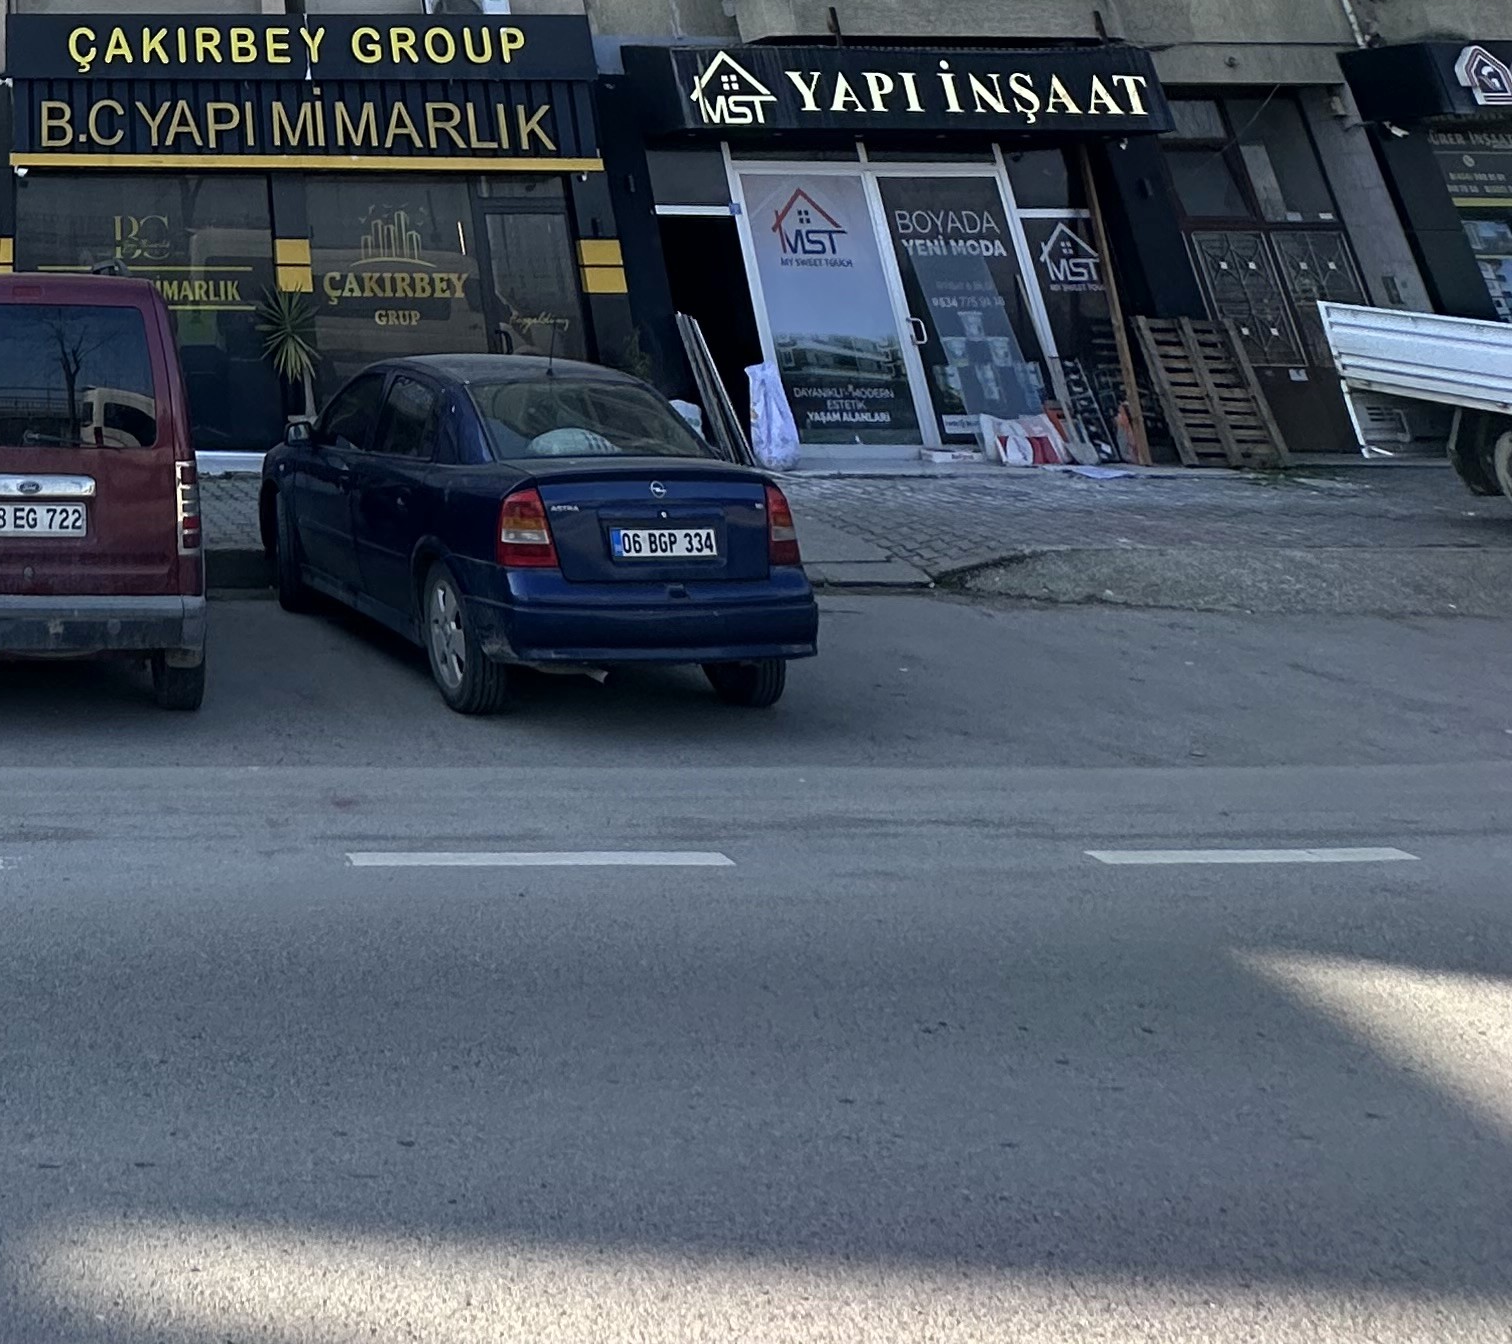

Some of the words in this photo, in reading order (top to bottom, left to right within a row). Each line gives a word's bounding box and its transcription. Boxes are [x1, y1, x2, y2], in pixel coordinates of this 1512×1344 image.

[68, 27, 325, 72] ÇAKIRBEY
[351, 27, 527, 64] GROUP
[701, 96, 777, 124] MST
[785, 70, 923, 113] YAPI
[937, 59, 1149, 124] İNŞAAT
[135, 99, 255, 150] YAPI
[271, 86, 558, 151] MİMARLIK
[895, 210, 1001, 234] BOYADA
[778, 228, 848, 255] MST
[901, 234, 949, 257] YENİ
[949, 239, 1007, 257] MODA
[1044, 257, 1100, 281] MST
[323, 272, 470, 305] ÇAKIRBEY
[374, 310, 422, 326] GRUP
[13, 507, 38, 529] EG
[46, 508, 83, 530] 722
[622, 532, 642, 554] 06
[648, 532, 678, 554] BGP
[683, 531, 714, 554] 334
